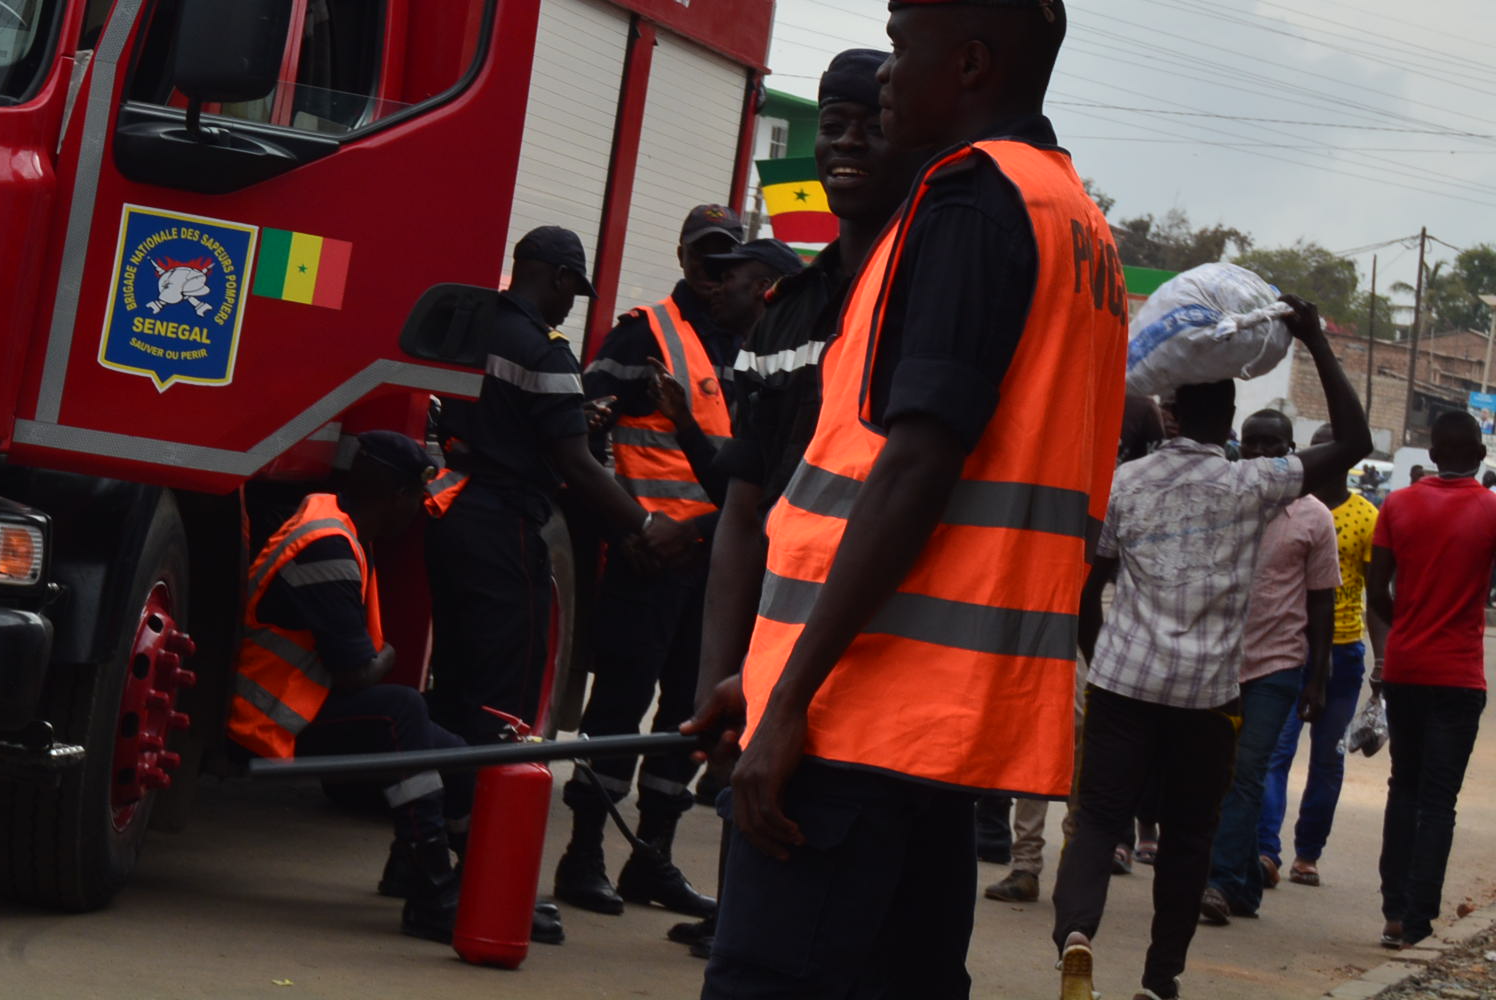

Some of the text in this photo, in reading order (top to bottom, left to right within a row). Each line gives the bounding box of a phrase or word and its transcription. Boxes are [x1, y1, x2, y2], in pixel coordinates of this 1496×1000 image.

[123, 227, 237, 325] BRIGADE NATIONALE DES SAPEURS POMPIERS
[132, 316, 212, 344] SENEGAL
[129, 337, 208, 360] SAUVER OU PERIR
